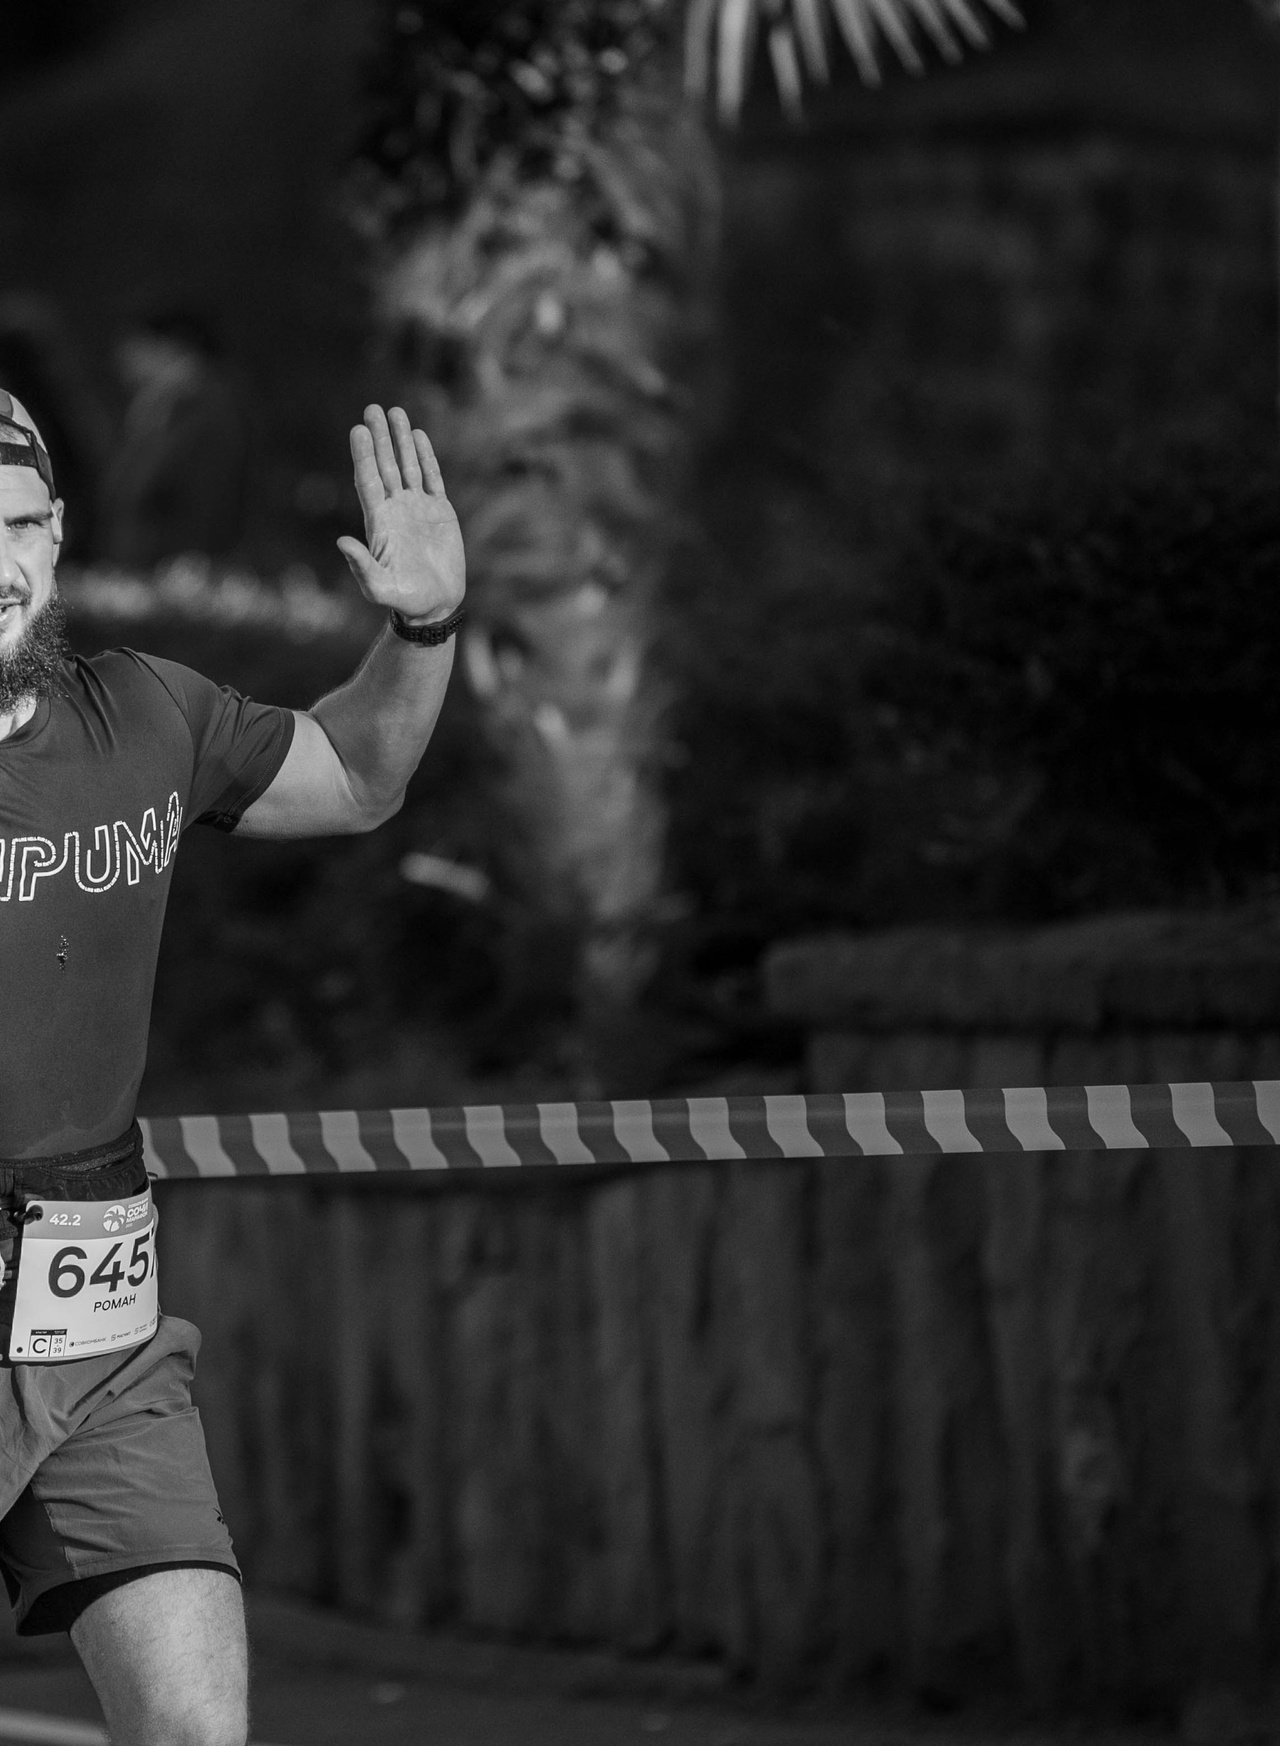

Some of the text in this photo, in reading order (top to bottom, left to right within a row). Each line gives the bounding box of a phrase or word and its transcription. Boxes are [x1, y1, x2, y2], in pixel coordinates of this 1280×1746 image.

[127, 1201, 148, 1218] СОЧИ
[49, 1213, 81, 1226] 42.2
[48, 1225, 157, 1298] 645
[93, 1293, 137, 1312] РОМАН
